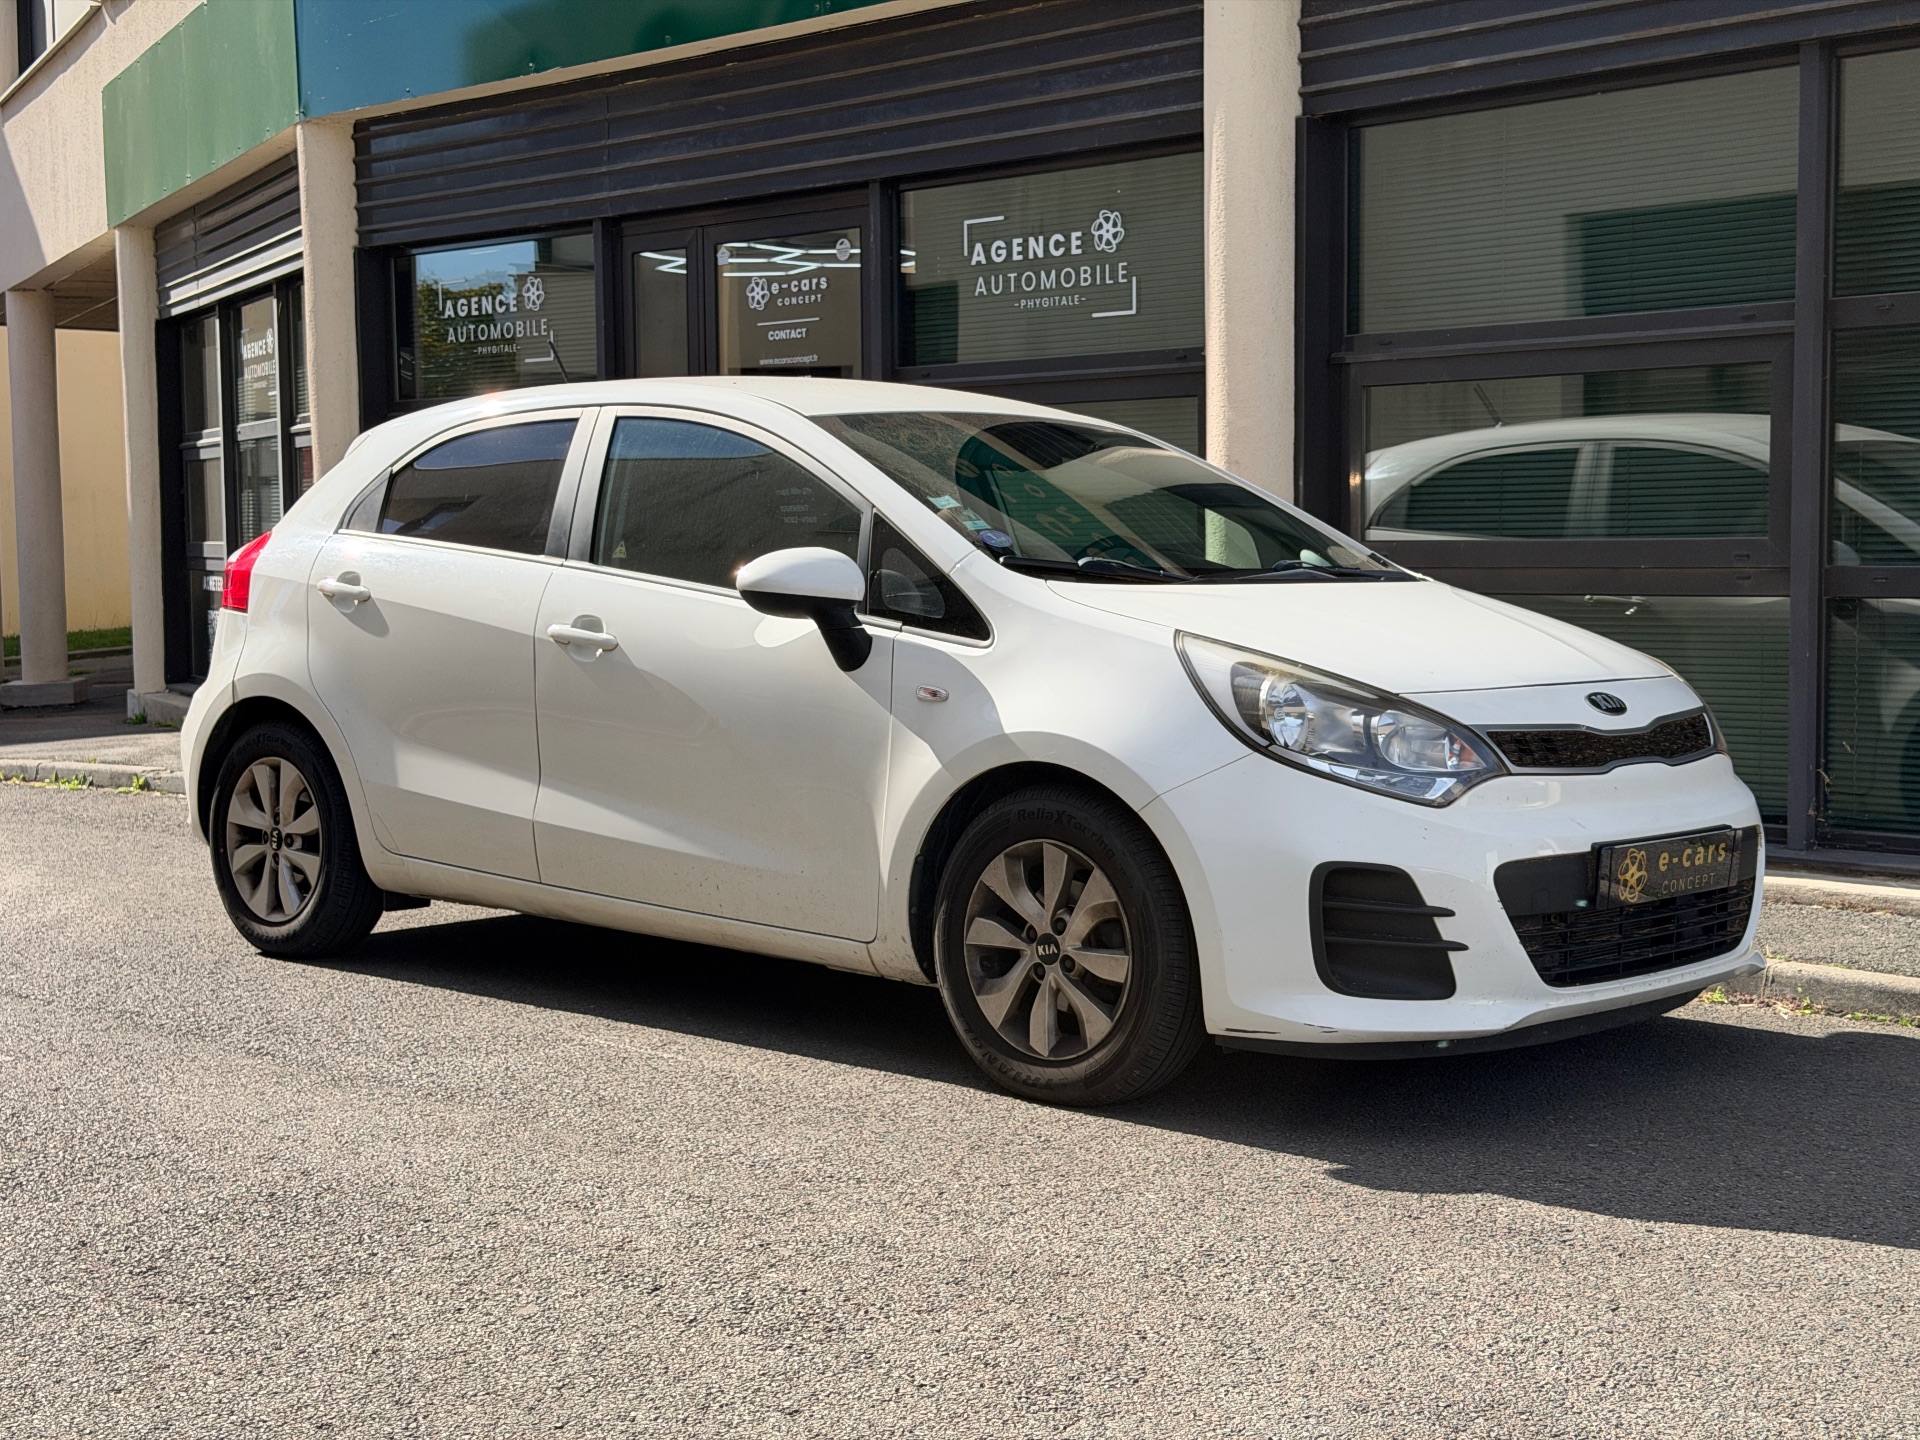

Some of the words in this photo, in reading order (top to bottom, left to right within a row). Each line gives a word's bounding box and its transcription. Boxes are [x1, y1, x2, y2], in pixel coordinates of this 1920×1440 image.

[970, 231, 1083, 266] AGENCE
[771, 277, 828, 294] e-cars
[974, 261, 1128, 296] AUTOMOBILE
[444, 292, 518, 318] AGENCE
[776, 293, 822, 306] CONCEPT
[1014, 294, 1087, 309] -PHYGITALE-
[447, 318, 548, 343] AUTOMOBILE
[767, 327, 807, 341] CONTACT
[242, 339, 267, 360] AGENCE
[244, 360, 276, 380] AUTOMOBILE
[203, 575, 224, 592] ACHETER
[1590, 693, 1626, 710] KIA
[1658, 841, 1728, 872] e-cars
[1660, 872, 1717, 895] CONCEPT
[1037, 943, 1059, 956] KIA
